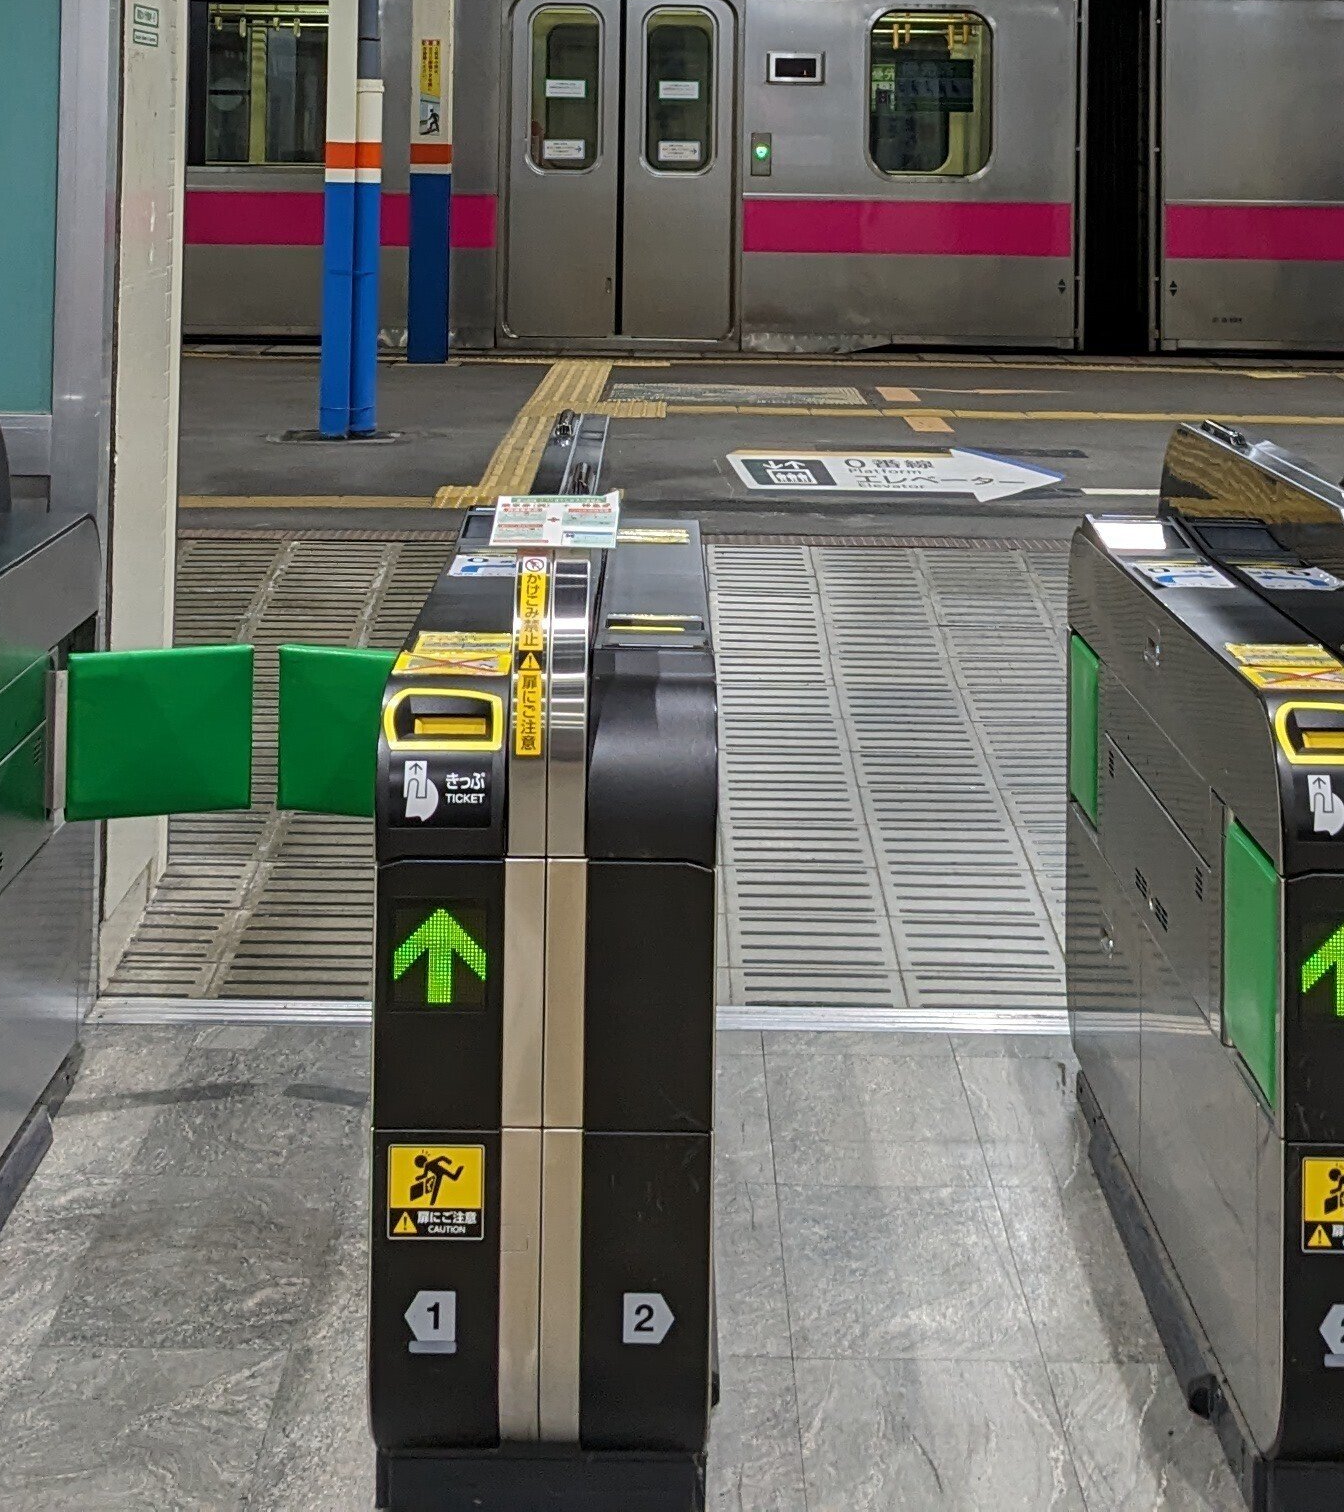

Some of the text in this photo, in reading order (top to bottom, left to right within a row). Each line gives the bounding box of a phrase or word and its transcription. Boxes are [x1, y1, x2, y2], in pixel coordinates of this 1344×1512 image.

[445, 773, 485, 790] きっぷ
[445, 793, 484, 804] TICKET
[417, 1210, 477, 1224] 扉にご注意
[428, 1225, 466, 1234] CAUTION
[427, 1302, 440, 1330] 1
[634, 1304, 654, 1332] 2
